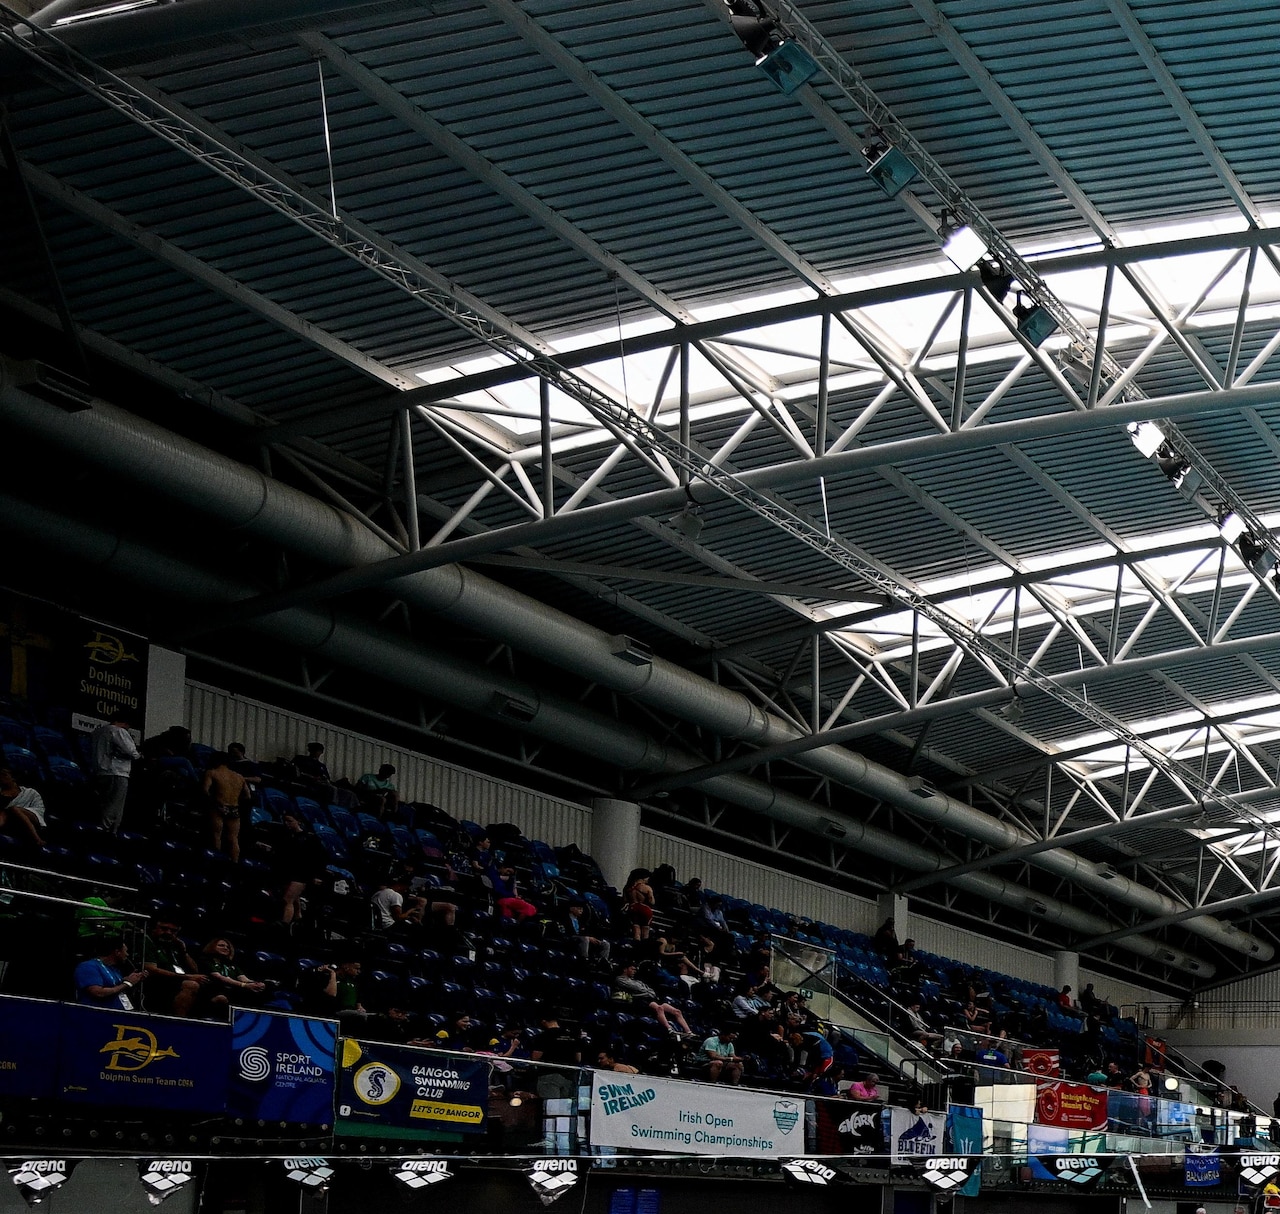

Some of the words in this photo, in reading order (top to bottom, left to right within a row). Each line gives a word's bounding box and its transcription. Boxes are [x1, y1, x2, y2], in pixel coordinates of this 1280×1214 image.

[89, 666, 131, 690] Dolphin
[80, 679, 138, 709] Swimming
[276, 1052, 311, 1065] SPORT
[276, 1063, 323, 1076] IRELAND
[412, 1065, 459, 1080] BANGOR
[100, 1071, 130, 1083] Dolphin
[132, 1074, 154, 1085] Swim
[156, 1076, 177, 1087] Team
[178, 1079, 195, 1088] CORK
[414, 1077, 470, 1091] SWIMMING
[417, 1087, 443, 1099] CLUB
[599, 1083, 634, 1101] SWIM
[603, 1088, 656, 1116] IRELAND
[433, 1106, 445, 1115] GO
[446, 1108, 481, 1119] BANGOR
[679, 1110, 702, 1124] Irish
[705, 1113, 733, 1128] Open
[631, 1124, 691, 1145] Swimming
[694, 1130, 773, 1150] Championships
[22, 1160, 66, 1171] arena
[148, 1160, 192, 1172] arena
[284, 1158, 329, 1170] arena
[401, 1160, 447, 1171] arena
[533, 1159, 577, 1171] arena
[926, 1158, 969, 1170] arena
[1056, 1157, 1099, 1169] arena
[1240, 1155, 1280, 1167] arena
[791, 1159, 837, 1180] arena
